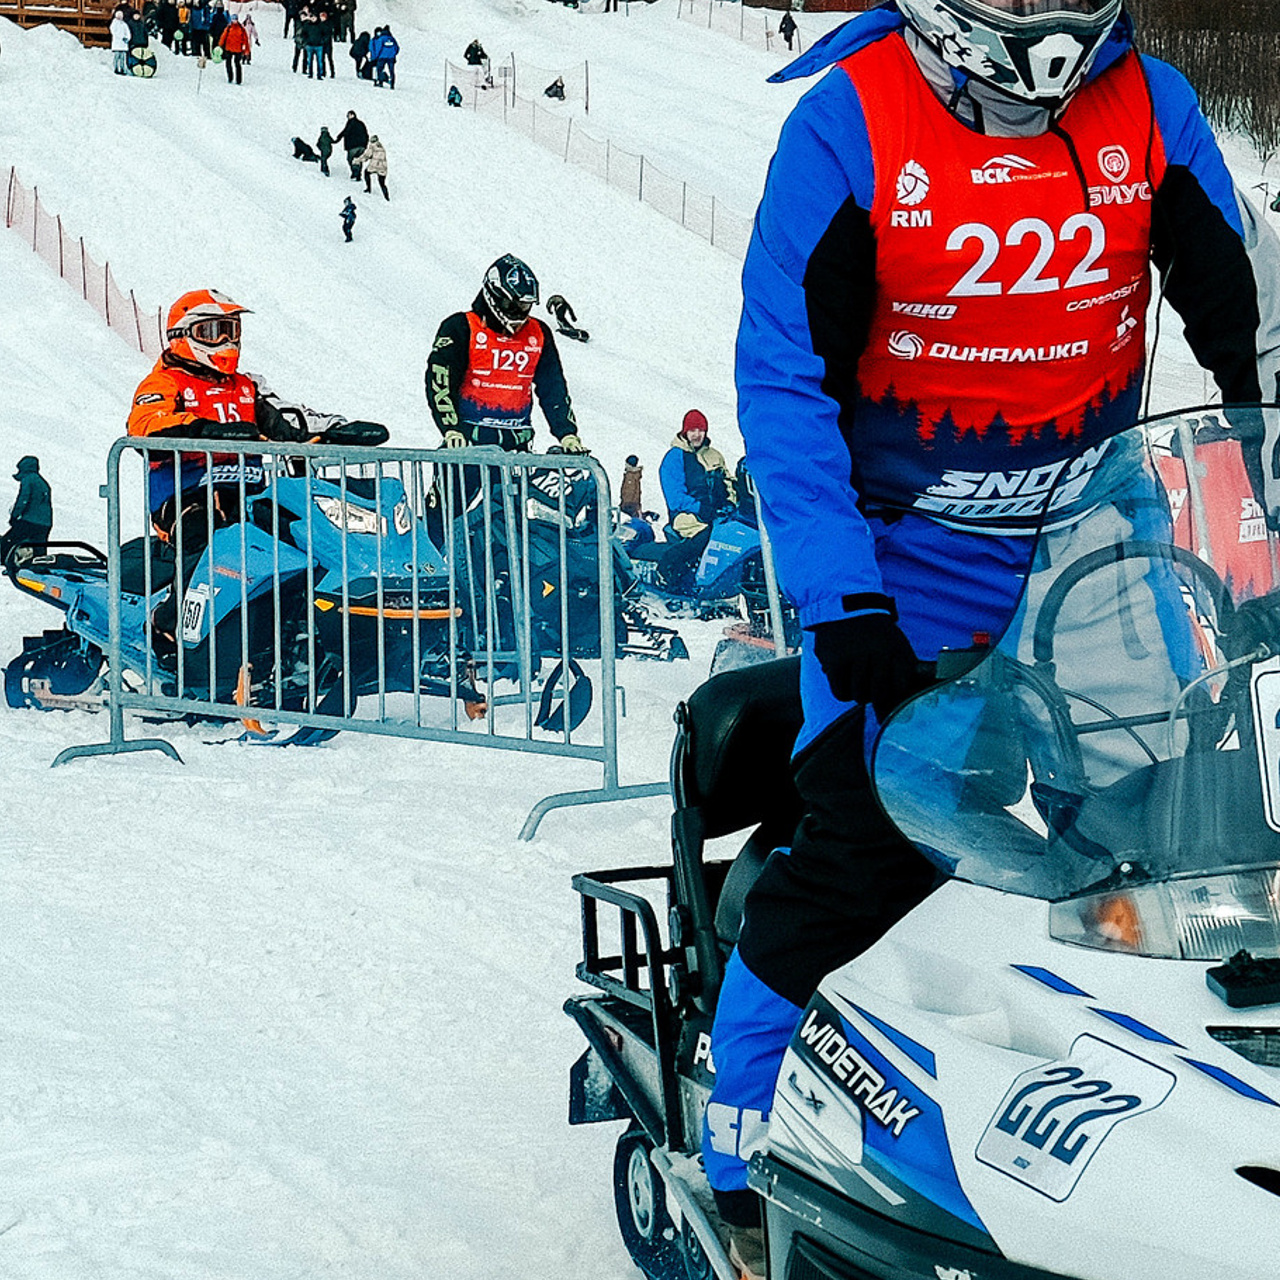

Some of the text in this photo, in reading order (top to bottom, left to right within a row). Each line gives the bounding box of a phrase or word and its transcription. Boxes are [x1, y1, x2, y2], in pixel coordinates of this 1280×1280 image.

[970, 168, 1012, 185] ВСК
[891, 209, 933, 228] RM
[945, 212, 1110, 298] 222
[490, 348, 530, 372] 129
[800, 1008, 920, 1137] WIDETRAK
[994, 1066, 1142, 1166] 222
